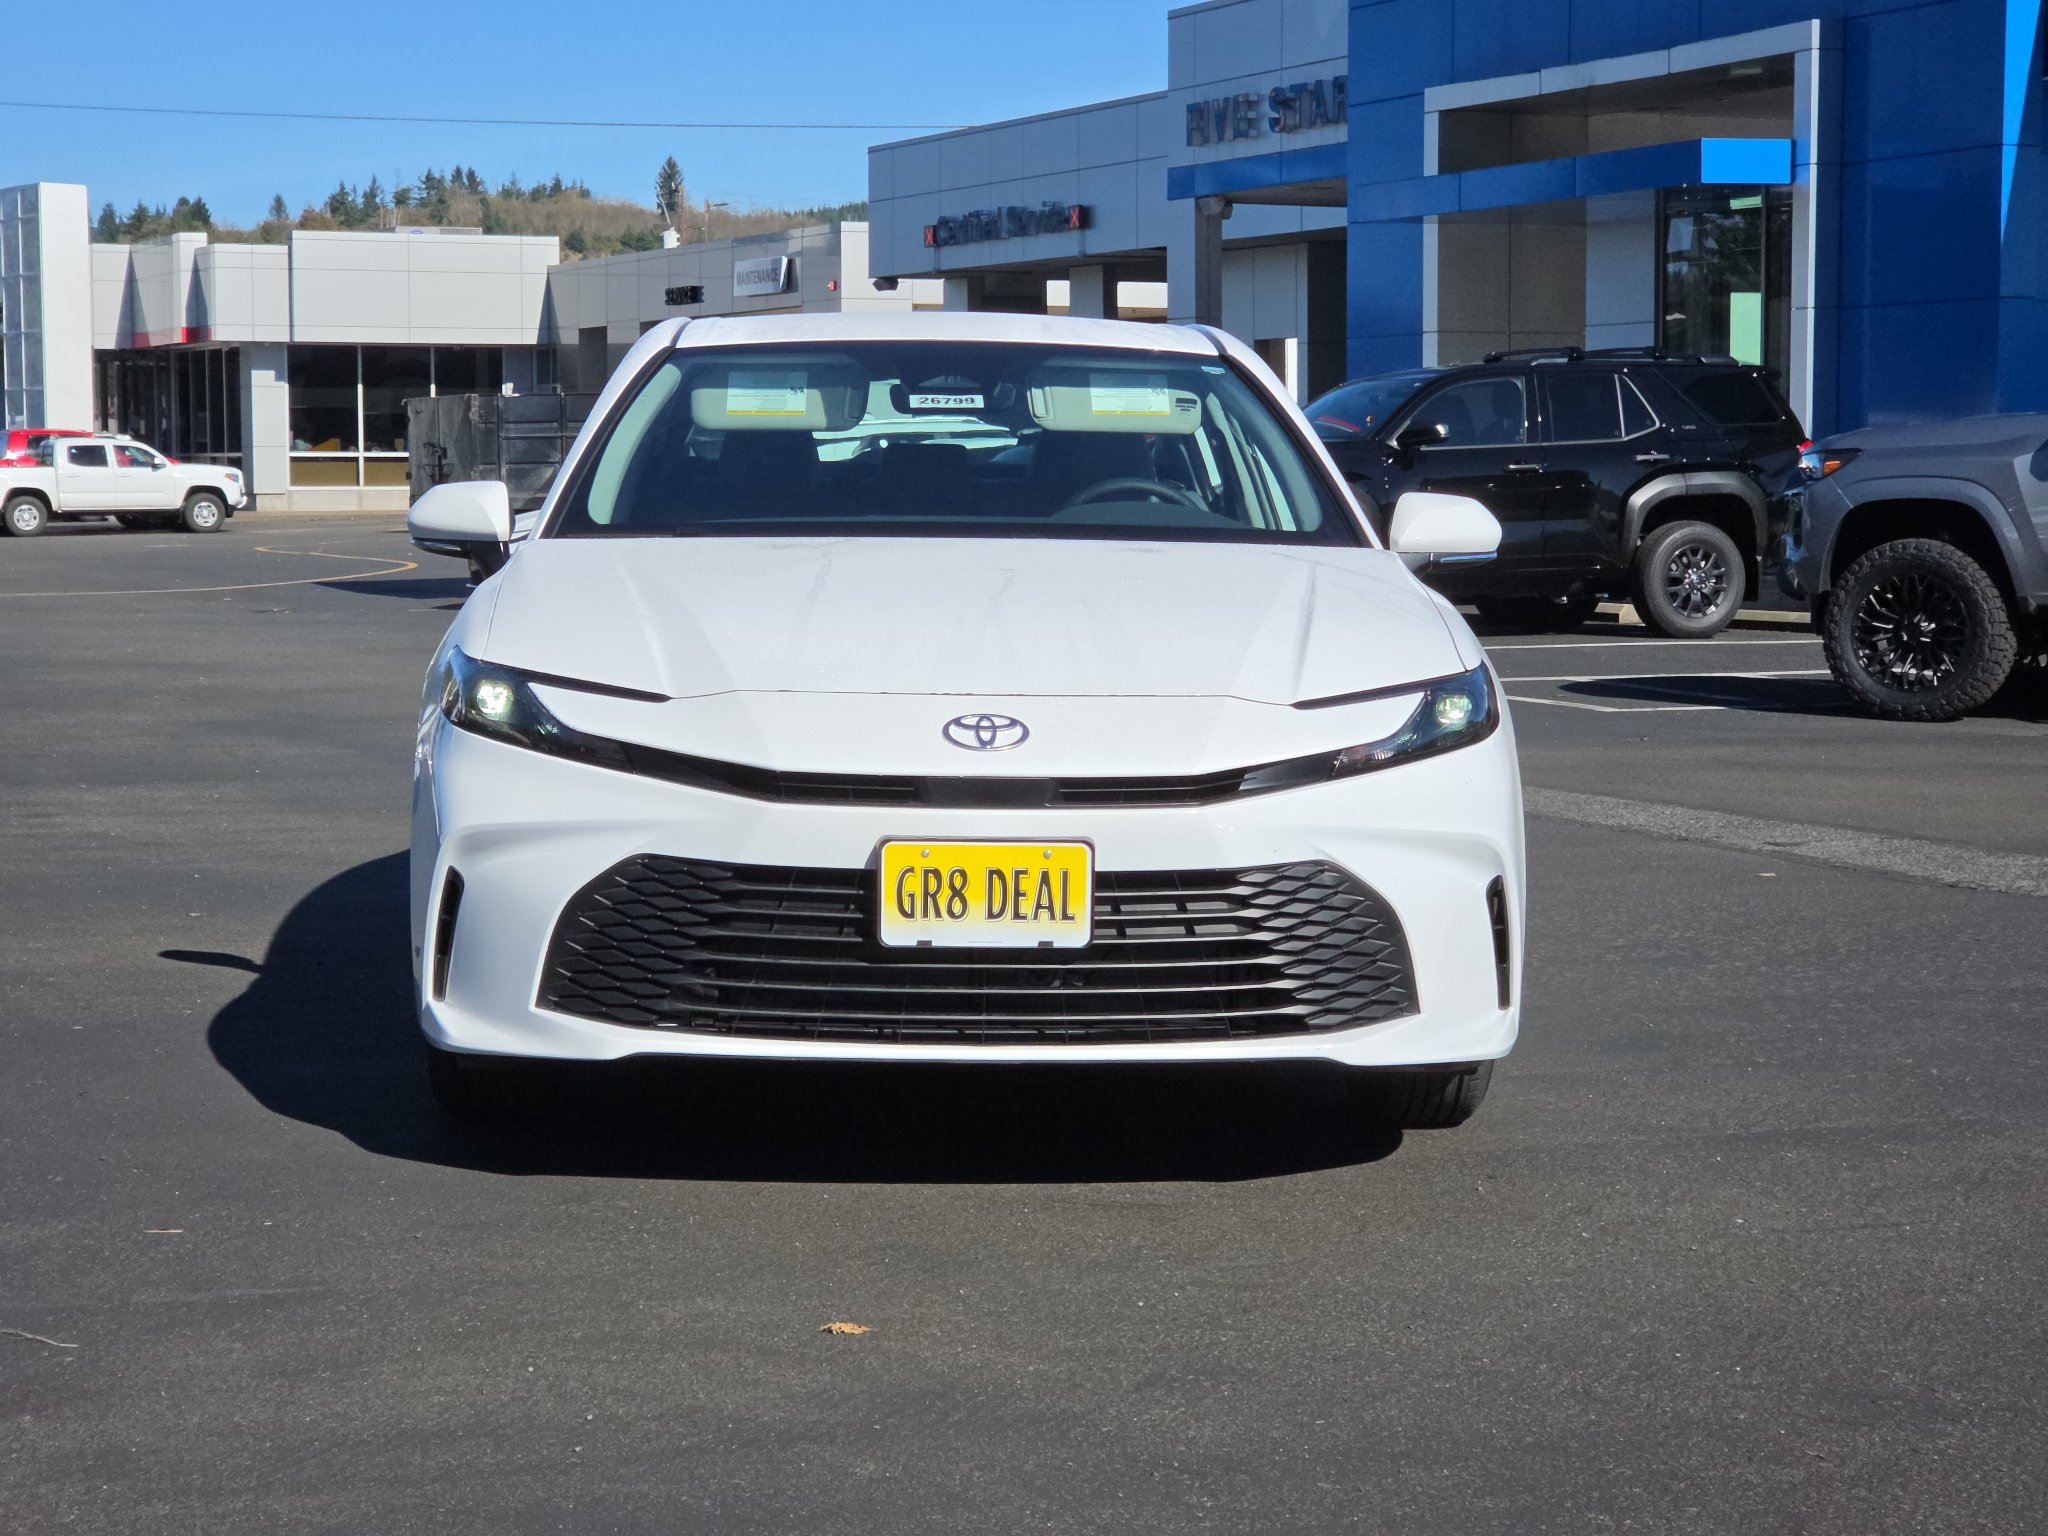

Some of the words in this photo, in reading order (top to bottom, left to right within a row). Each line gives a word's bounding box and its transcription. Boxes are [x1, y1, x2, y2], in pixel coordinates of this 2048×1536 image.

[1186, 92, 1260, 147] FIVE
[736, 267, 779, 286] MAINTENANCE
[919, 397, 975, 405] 26799
[896, 866, 971, 922] GR8
[984, 866, 1077, 923] DEAL
